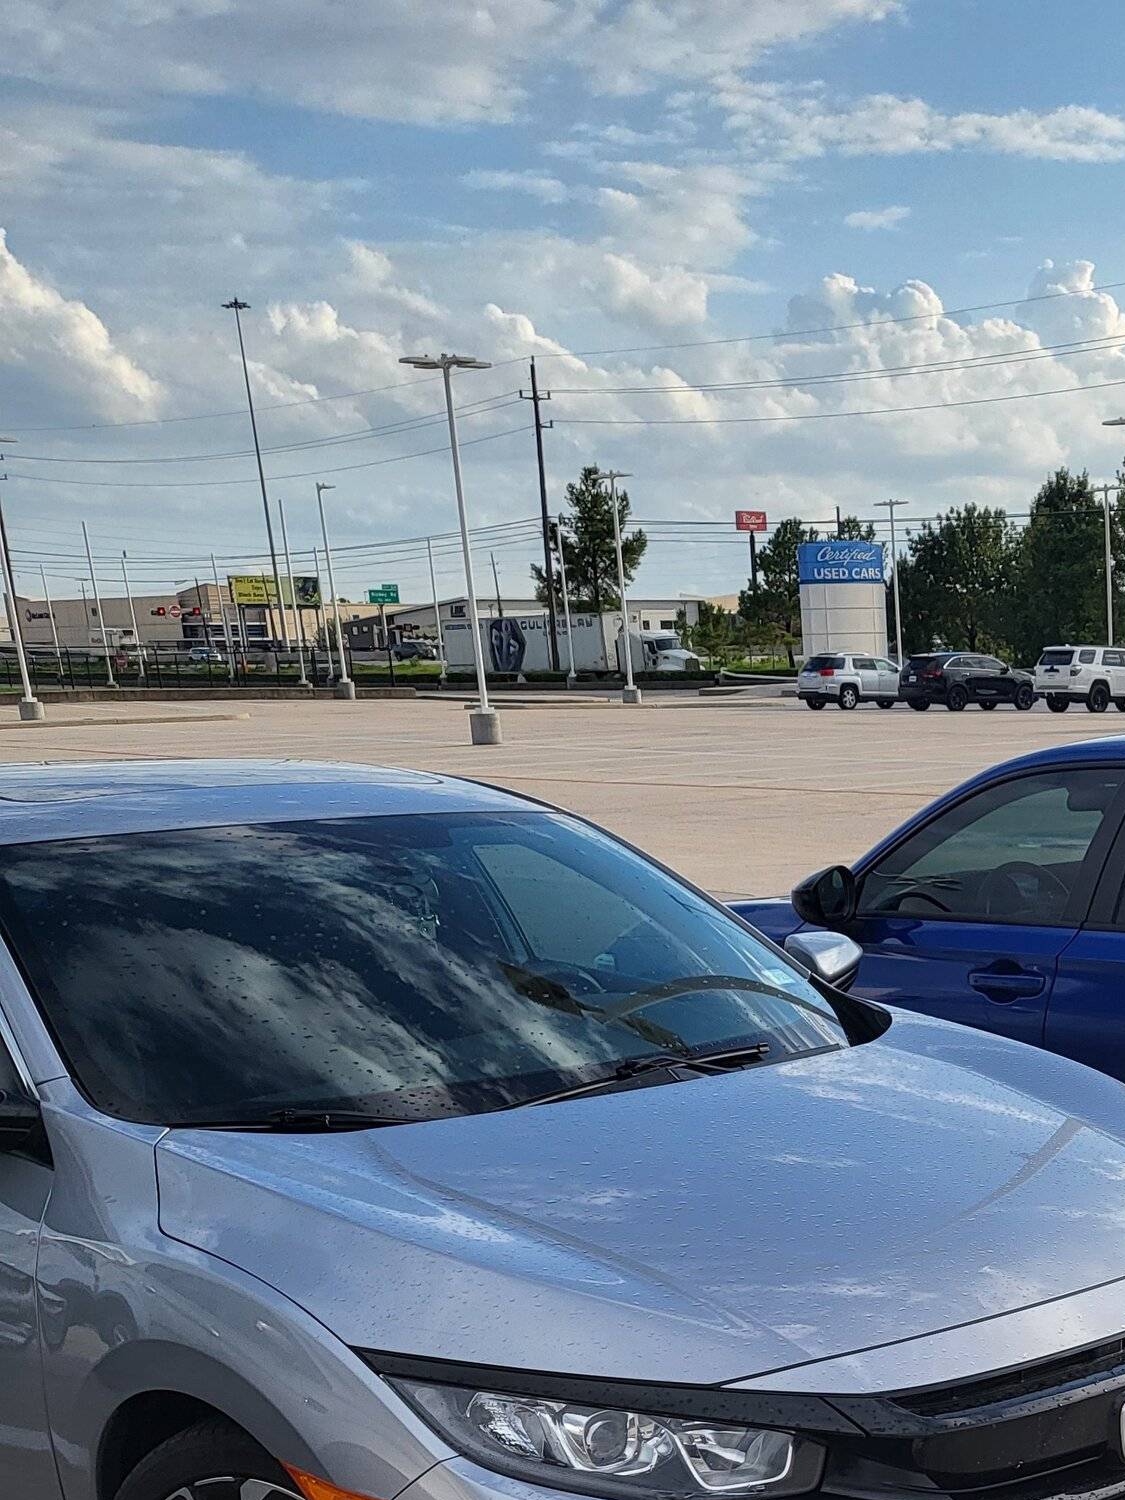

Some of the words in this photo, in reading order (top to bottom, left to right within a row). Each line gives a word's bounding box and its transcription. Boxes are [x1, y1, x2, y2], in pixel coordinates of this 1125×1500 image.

[817, 546, 877, 566] Certified
[814, 567, 849, 580] USED
[852, 567, 881, 580] CARS
